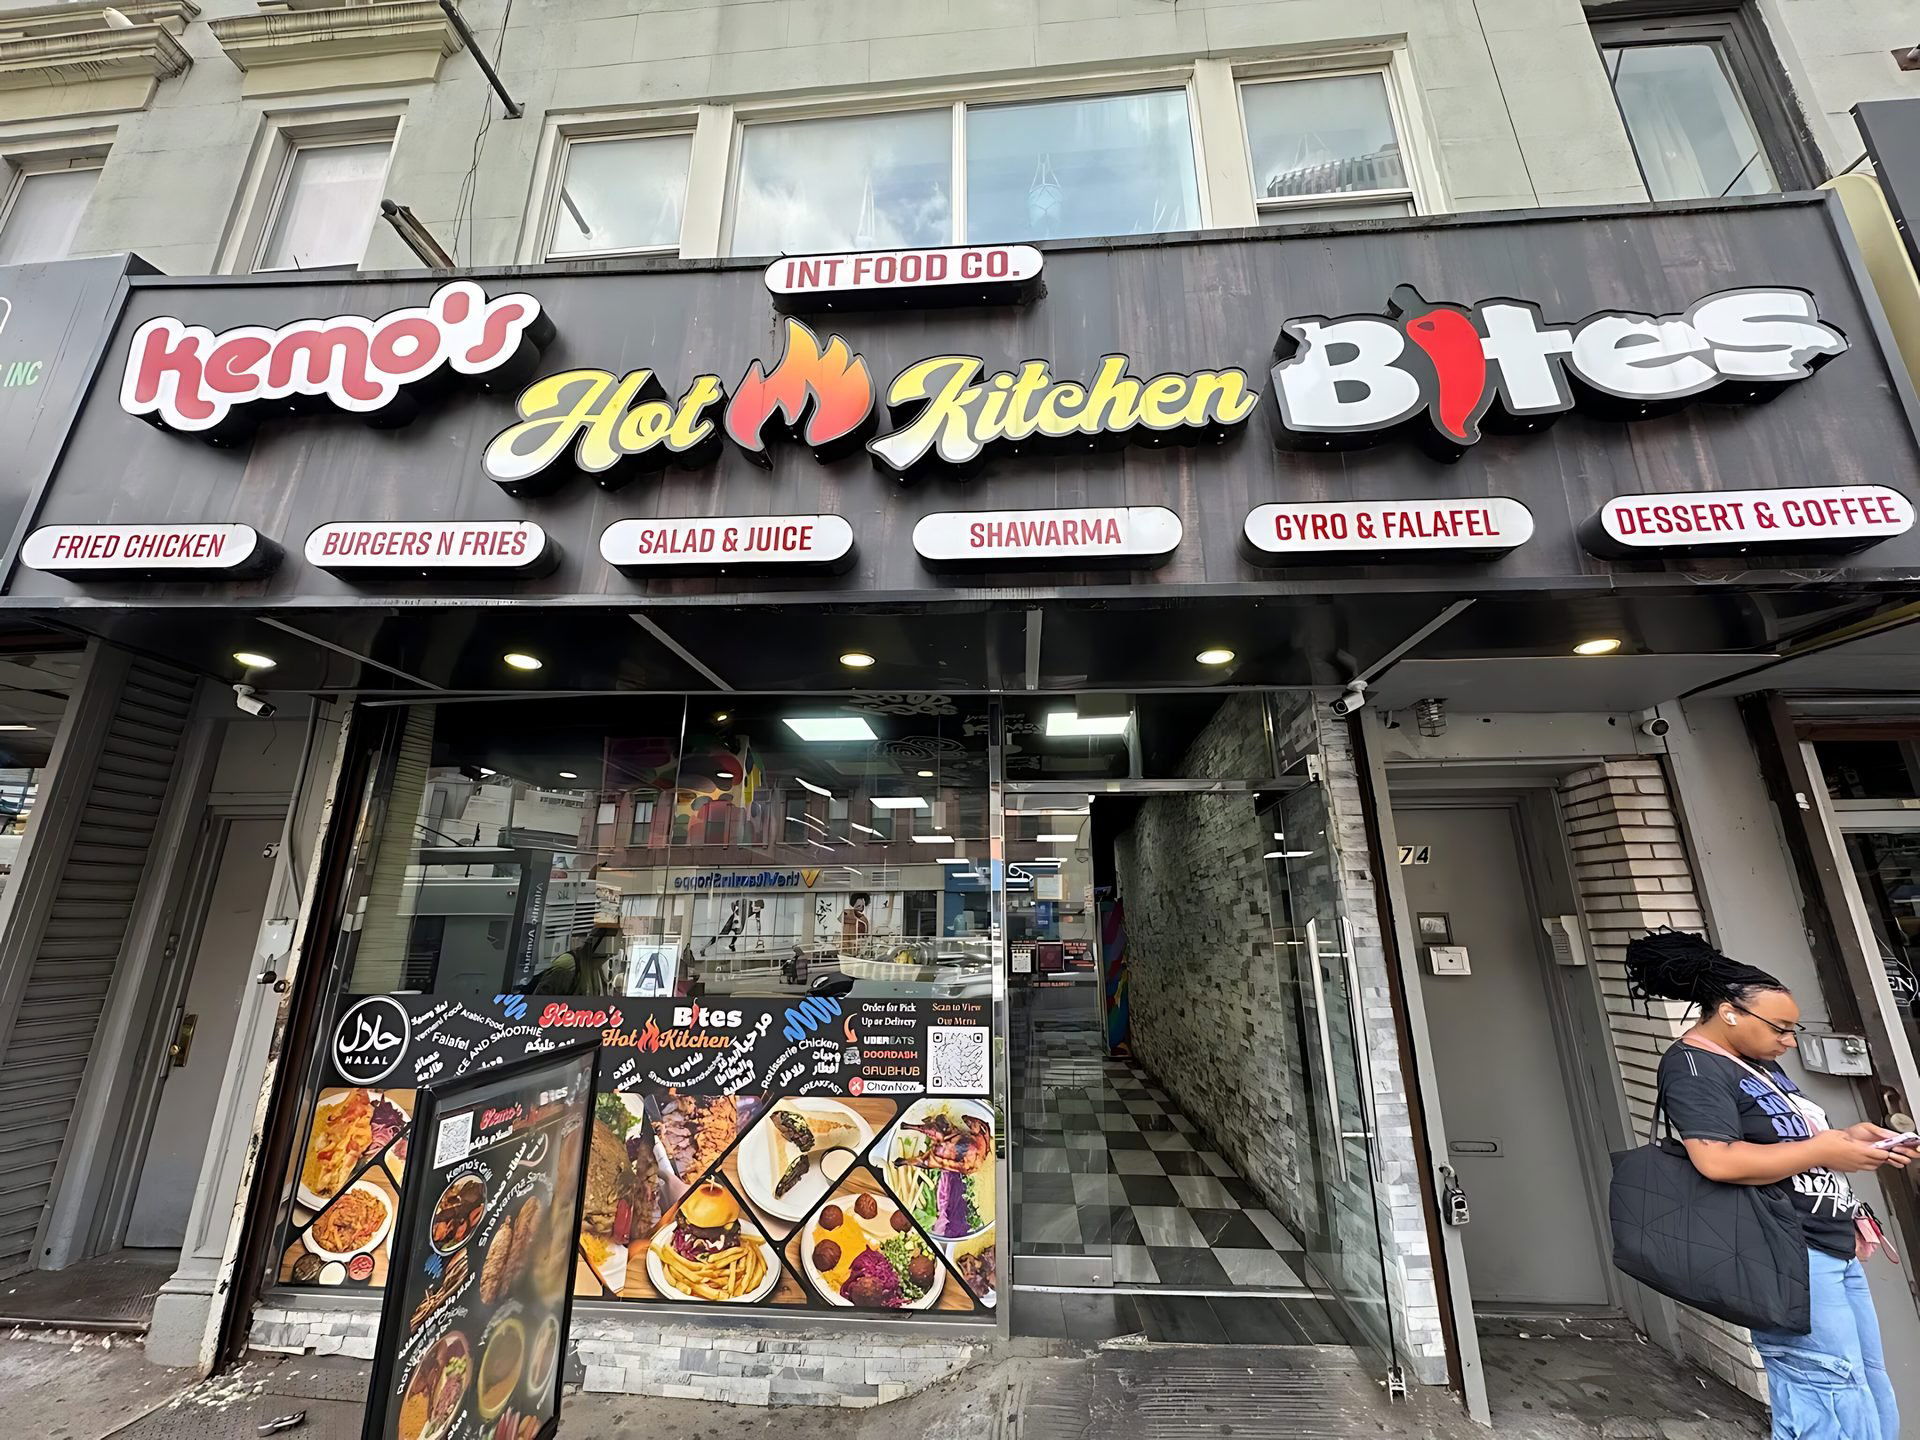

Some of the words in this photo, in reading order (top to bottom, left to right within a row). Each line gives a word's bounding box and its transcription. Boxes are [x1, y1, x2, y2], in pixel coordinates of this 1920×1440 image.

[784, 252, 844, 290] INT
[852, 253, 948, 285] FOOD
[959, 250, 1021, 280] CO.
[3, 360, 43, 388] INC
[484, 370, 720, 480] Hot
[868, 354, 1255, 470] Kitchen
[1274, 510, 1348, 542] GYRO
[1355, 509, 1377, 540] &
[1382, 508, 1501, 539] FALAFEL
[1614, 501, 1746, 537] DESSERT
[1753, 501, 1779, 530] &
[1780, 495, 1902, 531] COFFEE
[321, 532, 432, 557] BURGERS
[436, 530, 456, 556] N
[458, 530, 529, 556] FRIES
[638, 527, 715, 555] SALAD
[721, 527, 739, 553] &
[743, 525, 814, 553] JUICE
[968, 517, 1123, 549] SHAWARMA
[52, 534, 119, 560] FRIED
[122, 533, 227, 559] CHICKEN
[1400, 846, 1430, 864] 74
[634, 952, 666, 989] A
[443, 1001, 464, 1021] Food
[460, 1008, 485, 1024] Arabic
[484, 1017, 505, 1031] Food
[538, 1002, 625, 1029] Kemo's
[672, 998, 744, 1029] Bites
[862, 1002, 885, 1013] Order
[886, 1002, 899, 1013] for
[899, 1002, 917, 1012] Pick
[932, 1002, 951, 1012] Scan
[952, 1002, 962, 1012] to
[338, 1012, 403, 1053] حلال
[861, 1017, 873, 1028] Up
[873, 1018, 884, 1027] or
[884, 1017, 917, 1028] Delivery
[431, 1031, 471, 1051] Falafel
[469, 1038, 491, 1060] AND
[489, 1025, 544, 1043] SMOOTHIE
[600, 1028, 639, 1048] Hot
[658, 1028, 732, 1050] Kitchen
[798, 1037, 840, 1050] Chicken
[344, 1055, 390, 1066] HALAL
[863, 1050, 918, 1060] DOORDASH
[862, 1065, 921, 1077] GRUBHUB
[798, 1079, 844, 1096] BREAKFAST
[446, 1159, 480, 1183] Kemo's
[478, 1161, 494, 1184] Grill
